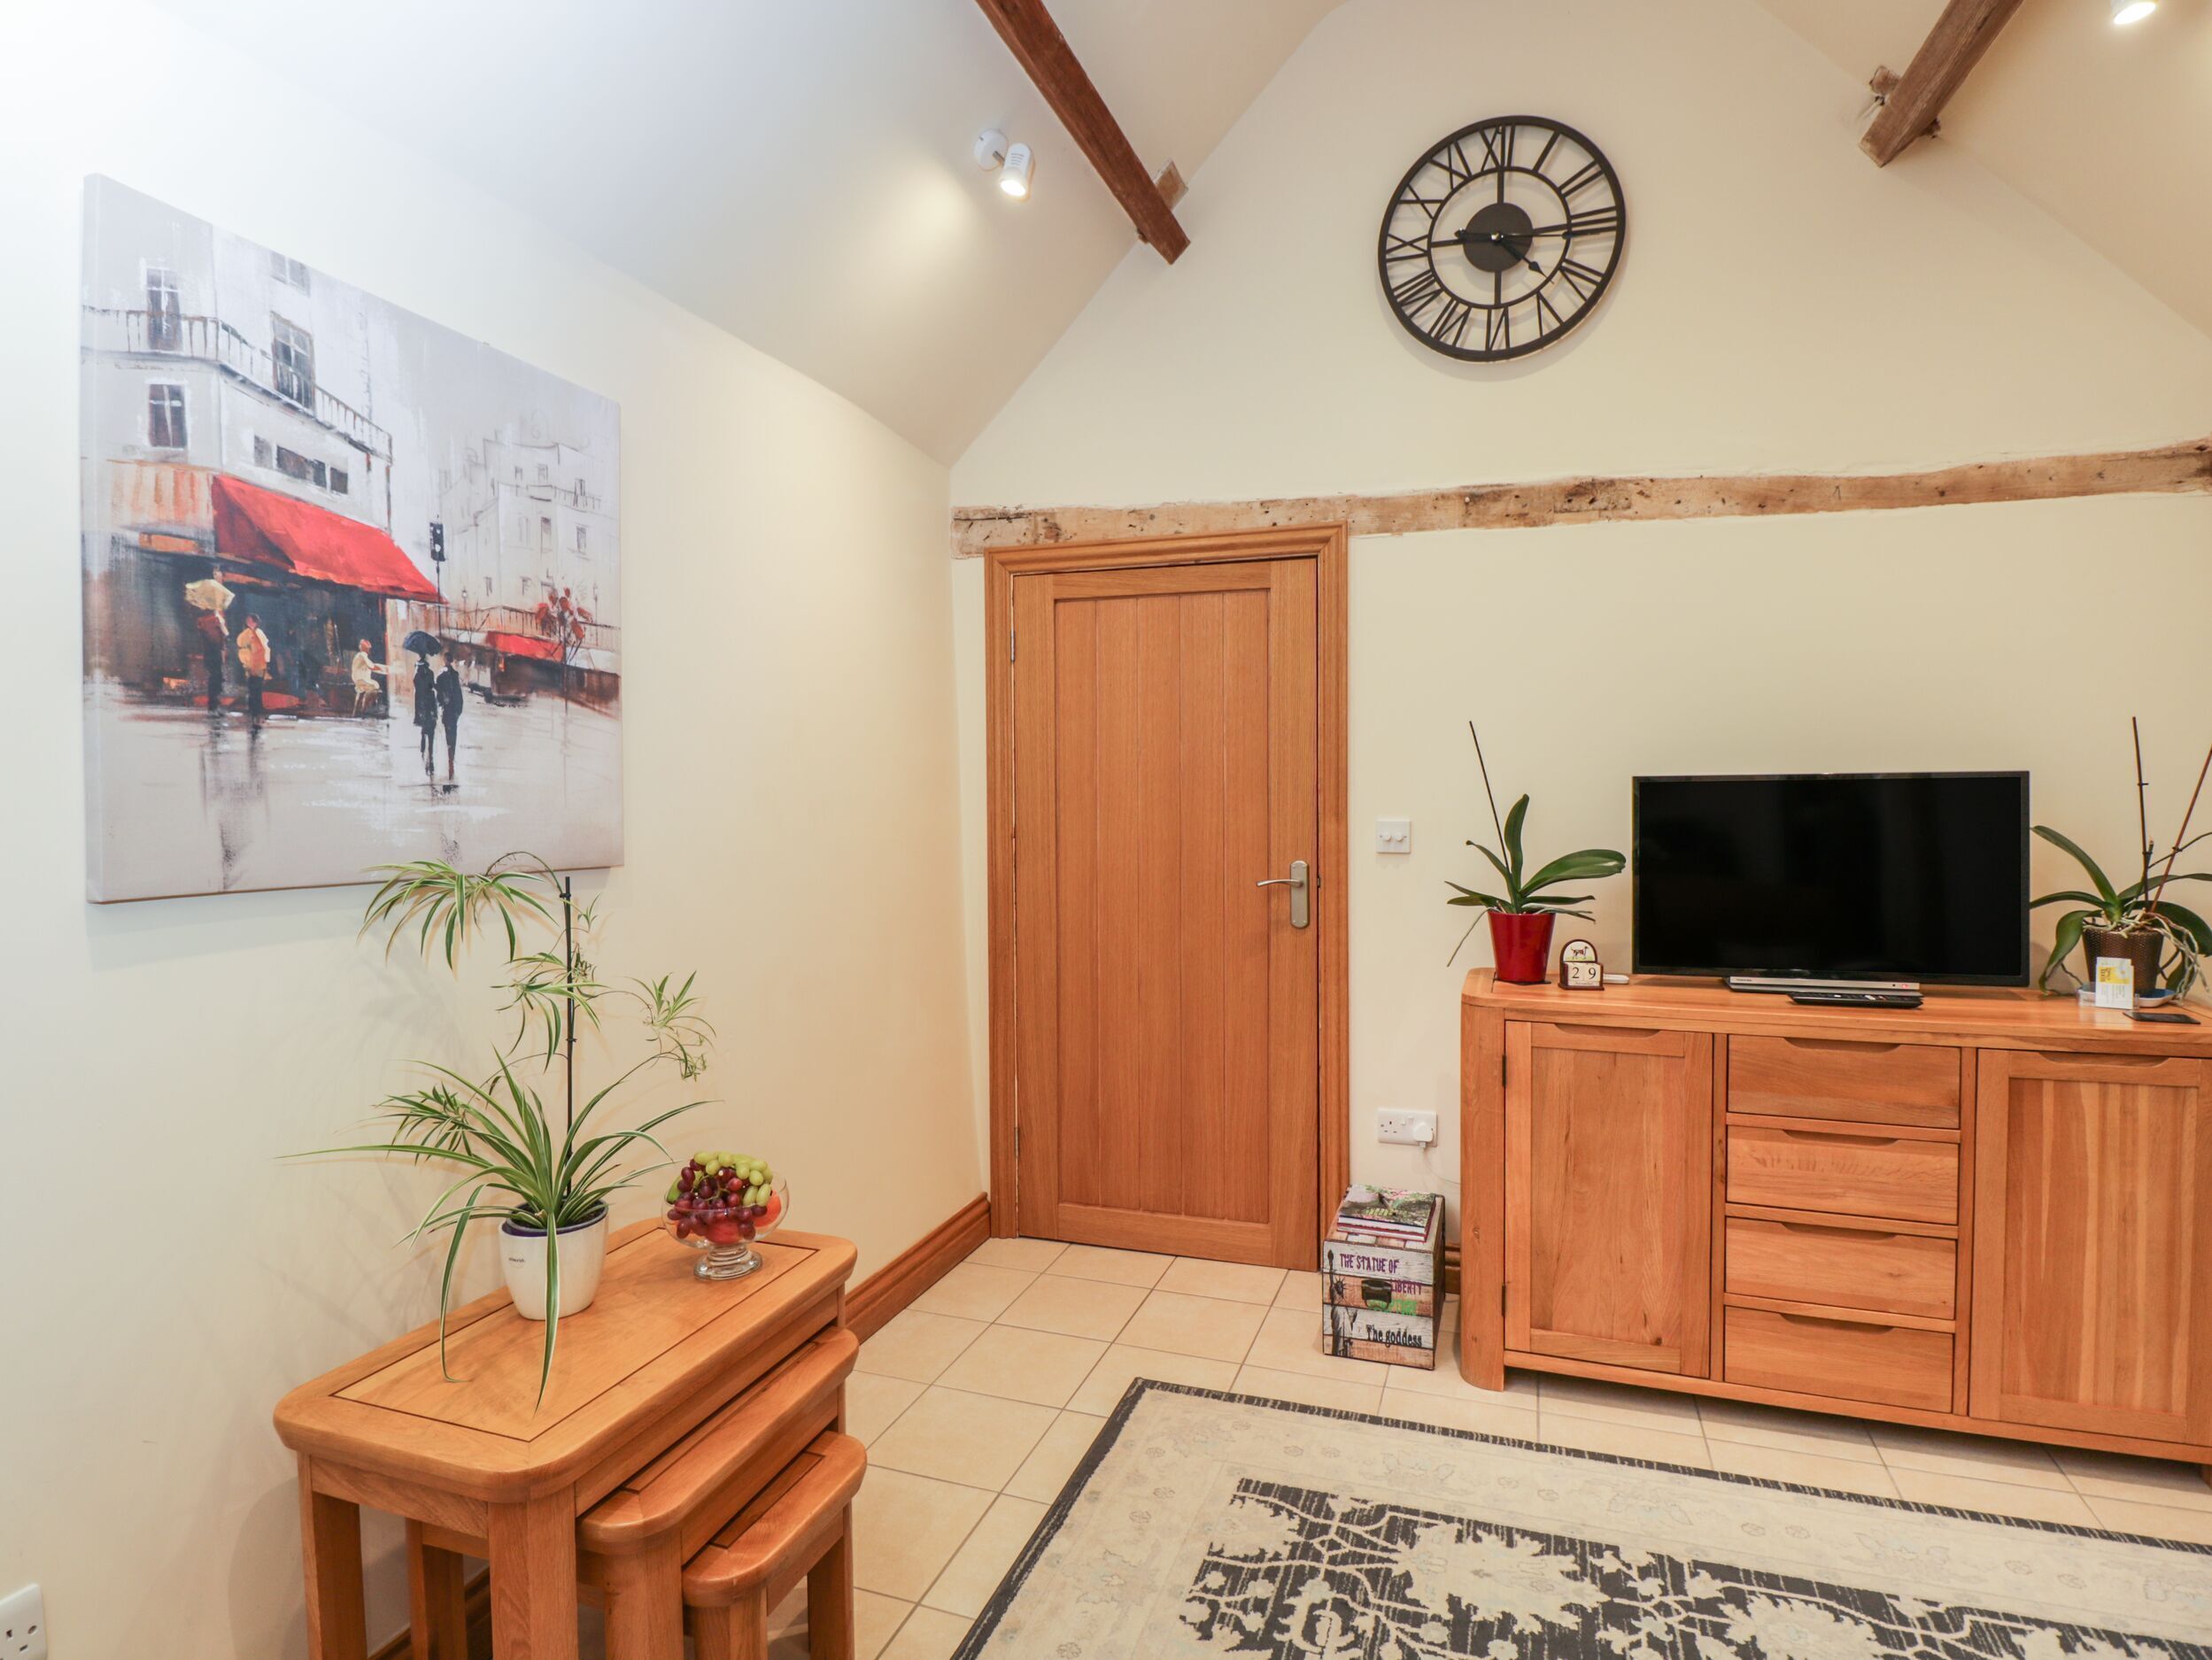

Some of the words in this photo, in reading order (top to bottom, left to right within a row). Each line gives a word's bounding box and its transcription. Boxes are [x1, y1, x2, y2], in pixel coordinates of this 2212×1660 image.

[1533, 129, 1560, 172] I
[1558, 159, 1605, 197] II
[1398, 182, 1444, 219] X
[1571, 205, 1617, 235] III
[1535, 291, 1565, 337] V
[1572, 967, 1580, 978] 2
[1588, 968, 1597, 979] 9
[1340, 1254, 1355, 1268] THE
[1357, 1255, 1388, 1272] STATUE
[1388, 1259, 1399, 1273] OF
[1390, 1278, 1422, 1294] LIBERTY
[1366, 1324, 1383, 1342] The
[1385, 1327, 1422, 1348] goddess
